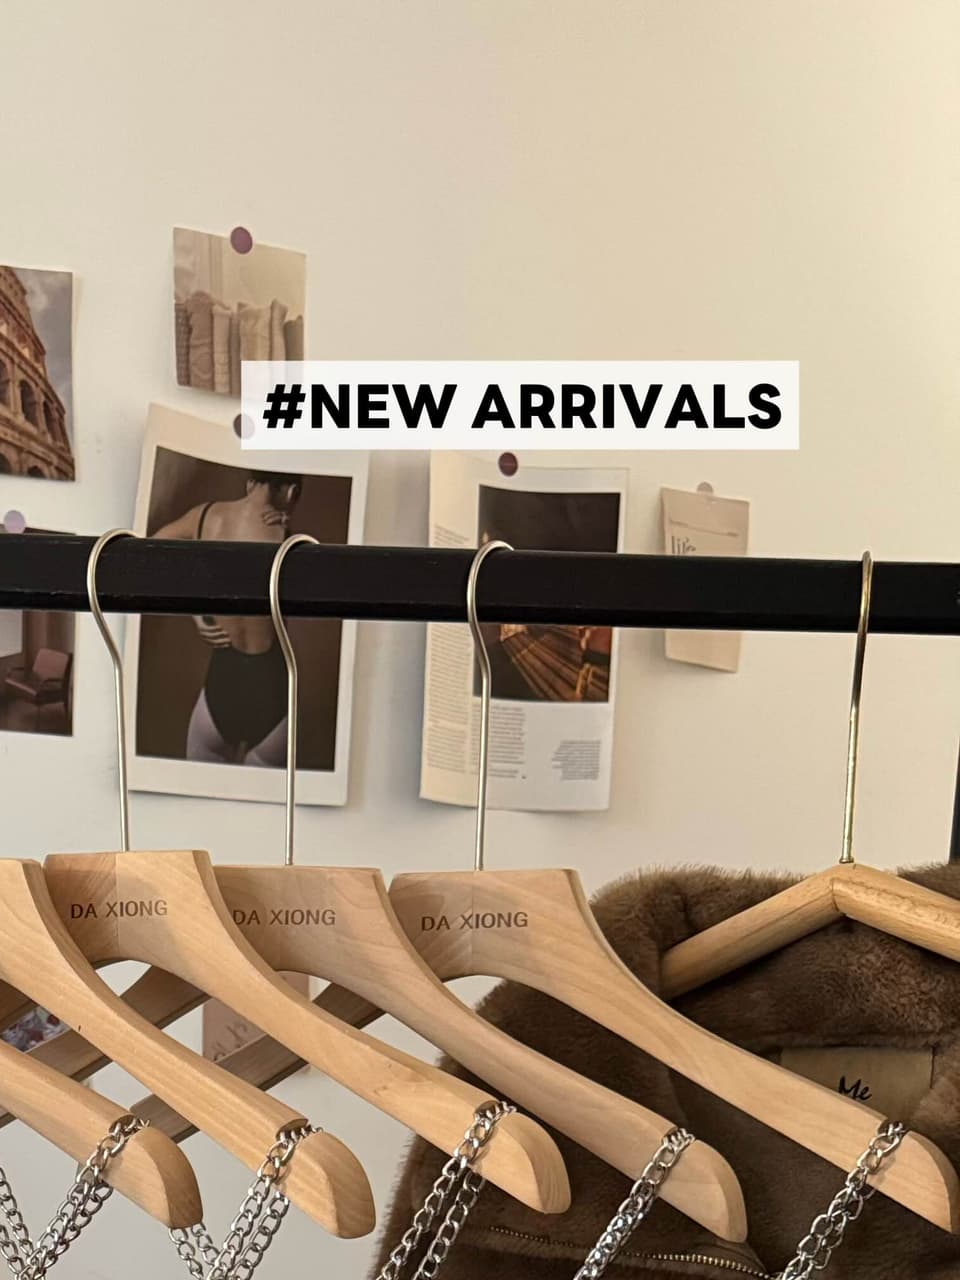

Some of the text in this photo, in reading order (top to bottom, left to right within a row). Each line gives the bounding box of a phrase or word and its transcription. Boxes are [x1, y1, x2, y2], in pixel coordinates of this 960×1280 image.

[71, 901, 168, 919] DA XIONG
[233, 909, 337, 926] DA XIONG
[421, 912, 529, 931] DA XIONG
